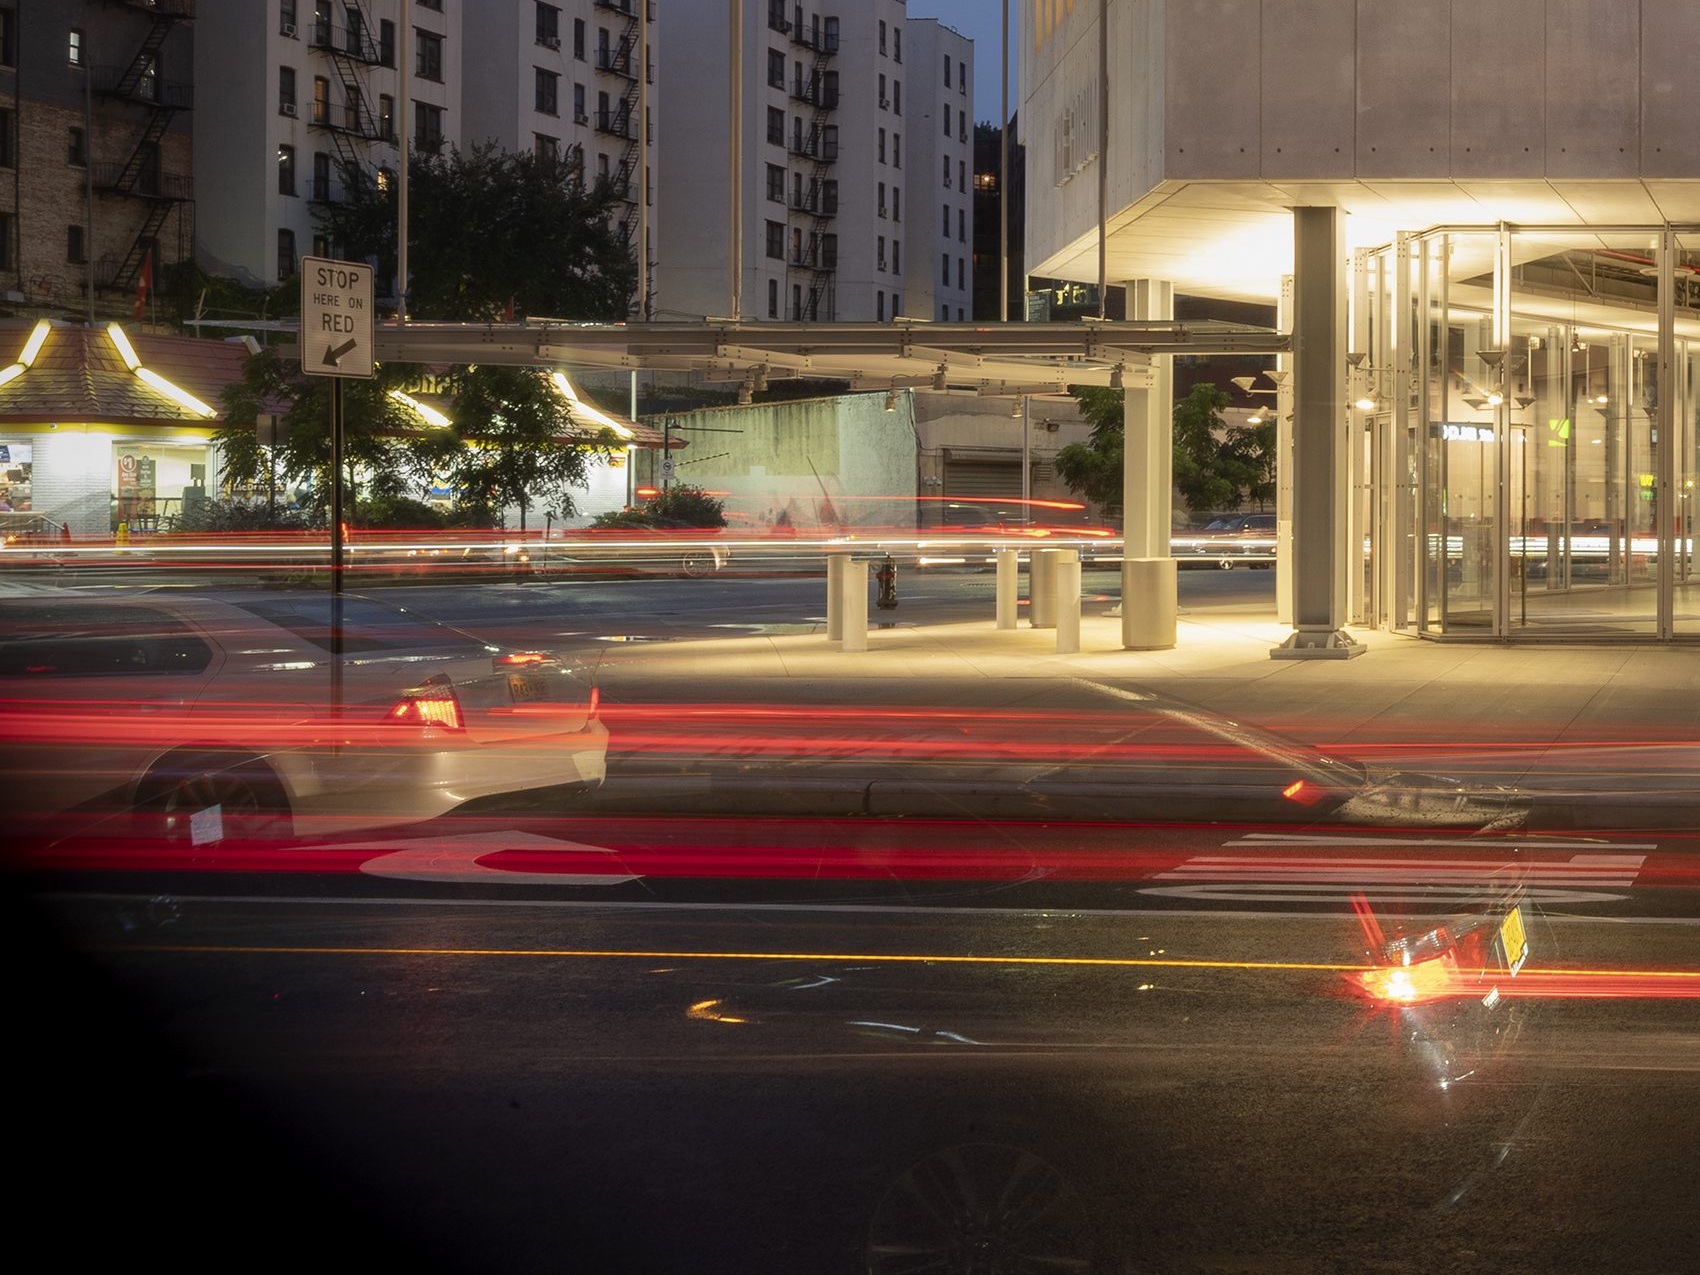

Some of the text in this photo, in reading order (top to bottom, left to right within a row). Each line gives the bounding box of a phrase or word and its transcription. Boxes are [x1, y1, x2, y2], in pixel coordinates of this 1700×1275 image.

[317, 267, 360, 290] STOP
[313, 293, 363, 309] HERE ON
[322, 313, 354, 333] RED
